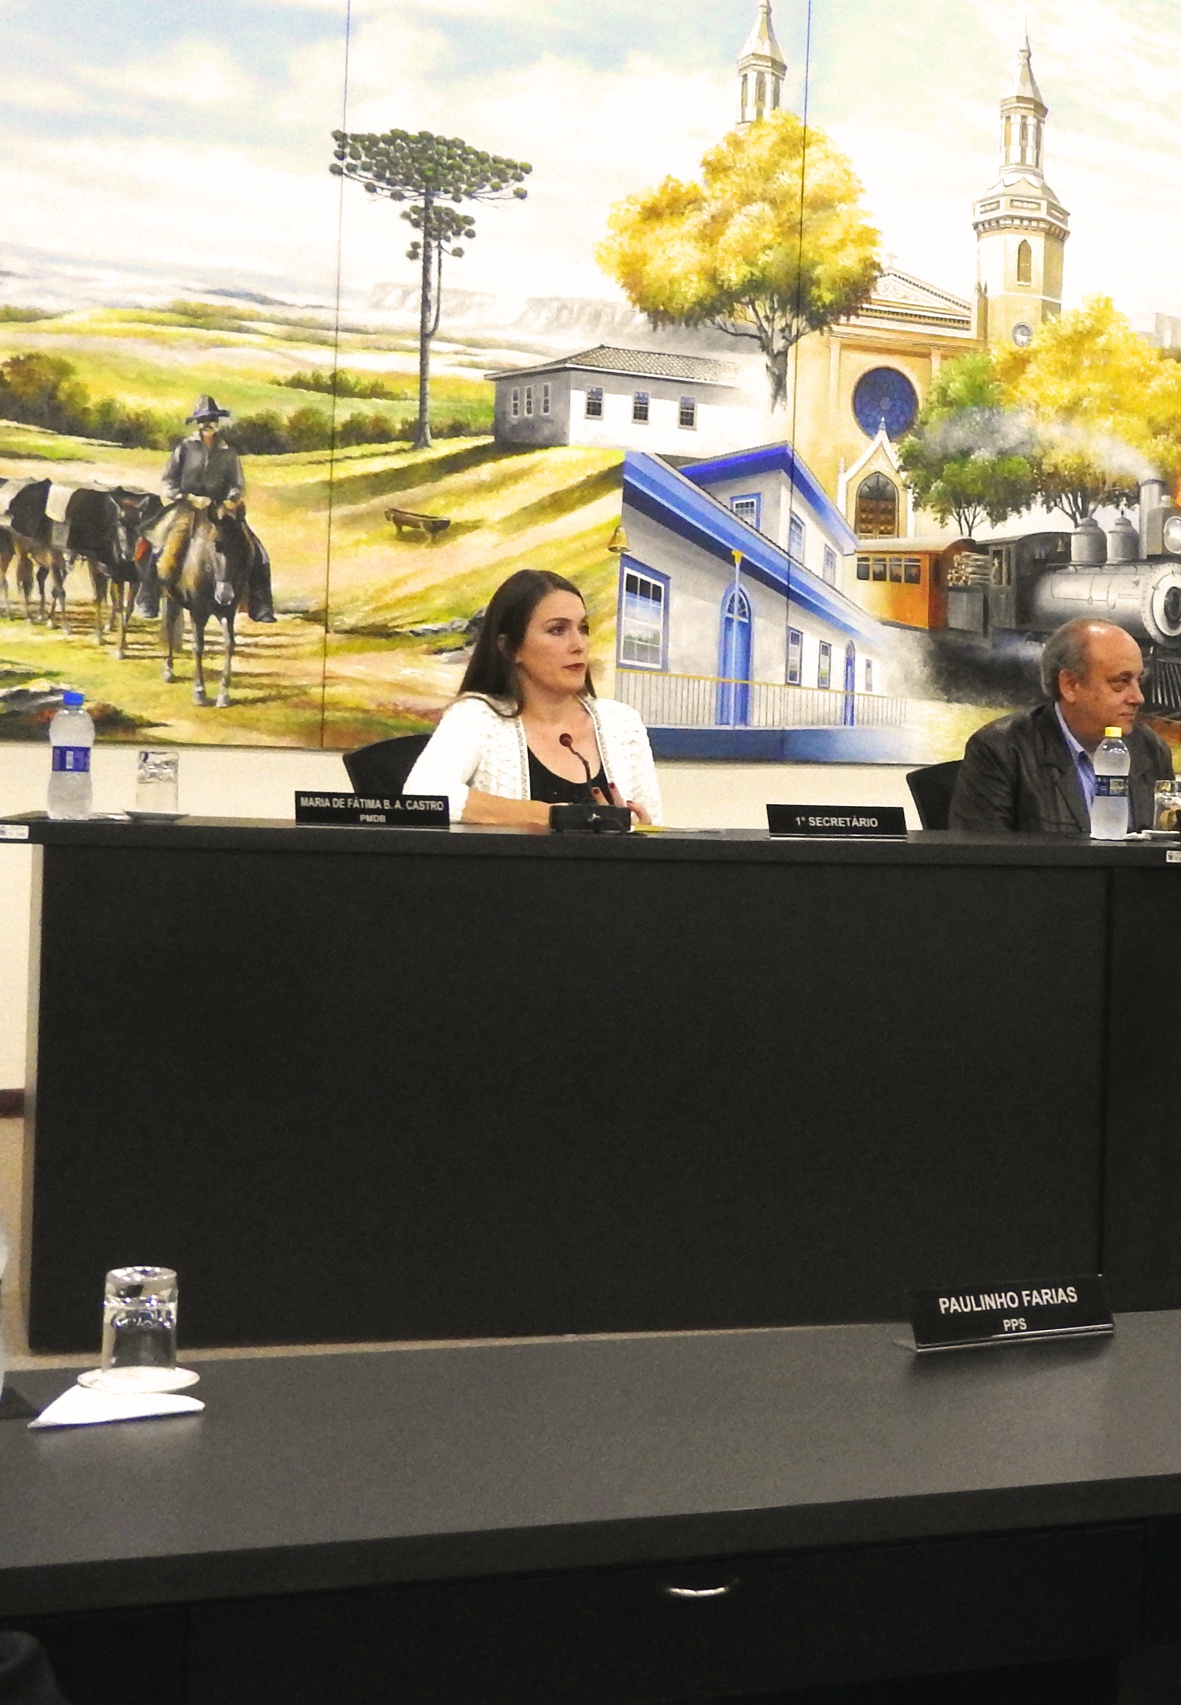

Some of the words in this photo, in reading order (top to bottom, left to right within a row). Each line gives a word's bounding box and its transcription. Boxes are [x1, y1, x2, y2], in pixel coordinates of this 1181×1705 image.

[300, 796, 331, 807] MARIA
[332, 797, 345, 808] DE
[347, 796, 382, 809] FÁTIMA
[384, 799, 393, 810] B.
[394, 799, 404, 810] A.
[405, 800, 444, 811] CASTRO
[360, 814, 386, 823] PMDB
[808, 815, 879, 828] SECRETÁRIO
[938, 1291, 1019, 1315] PAULINHO
[1021, 1286, 1078, 1307] FARIAS
[1002, 1317, 1028, 1332] PPS
